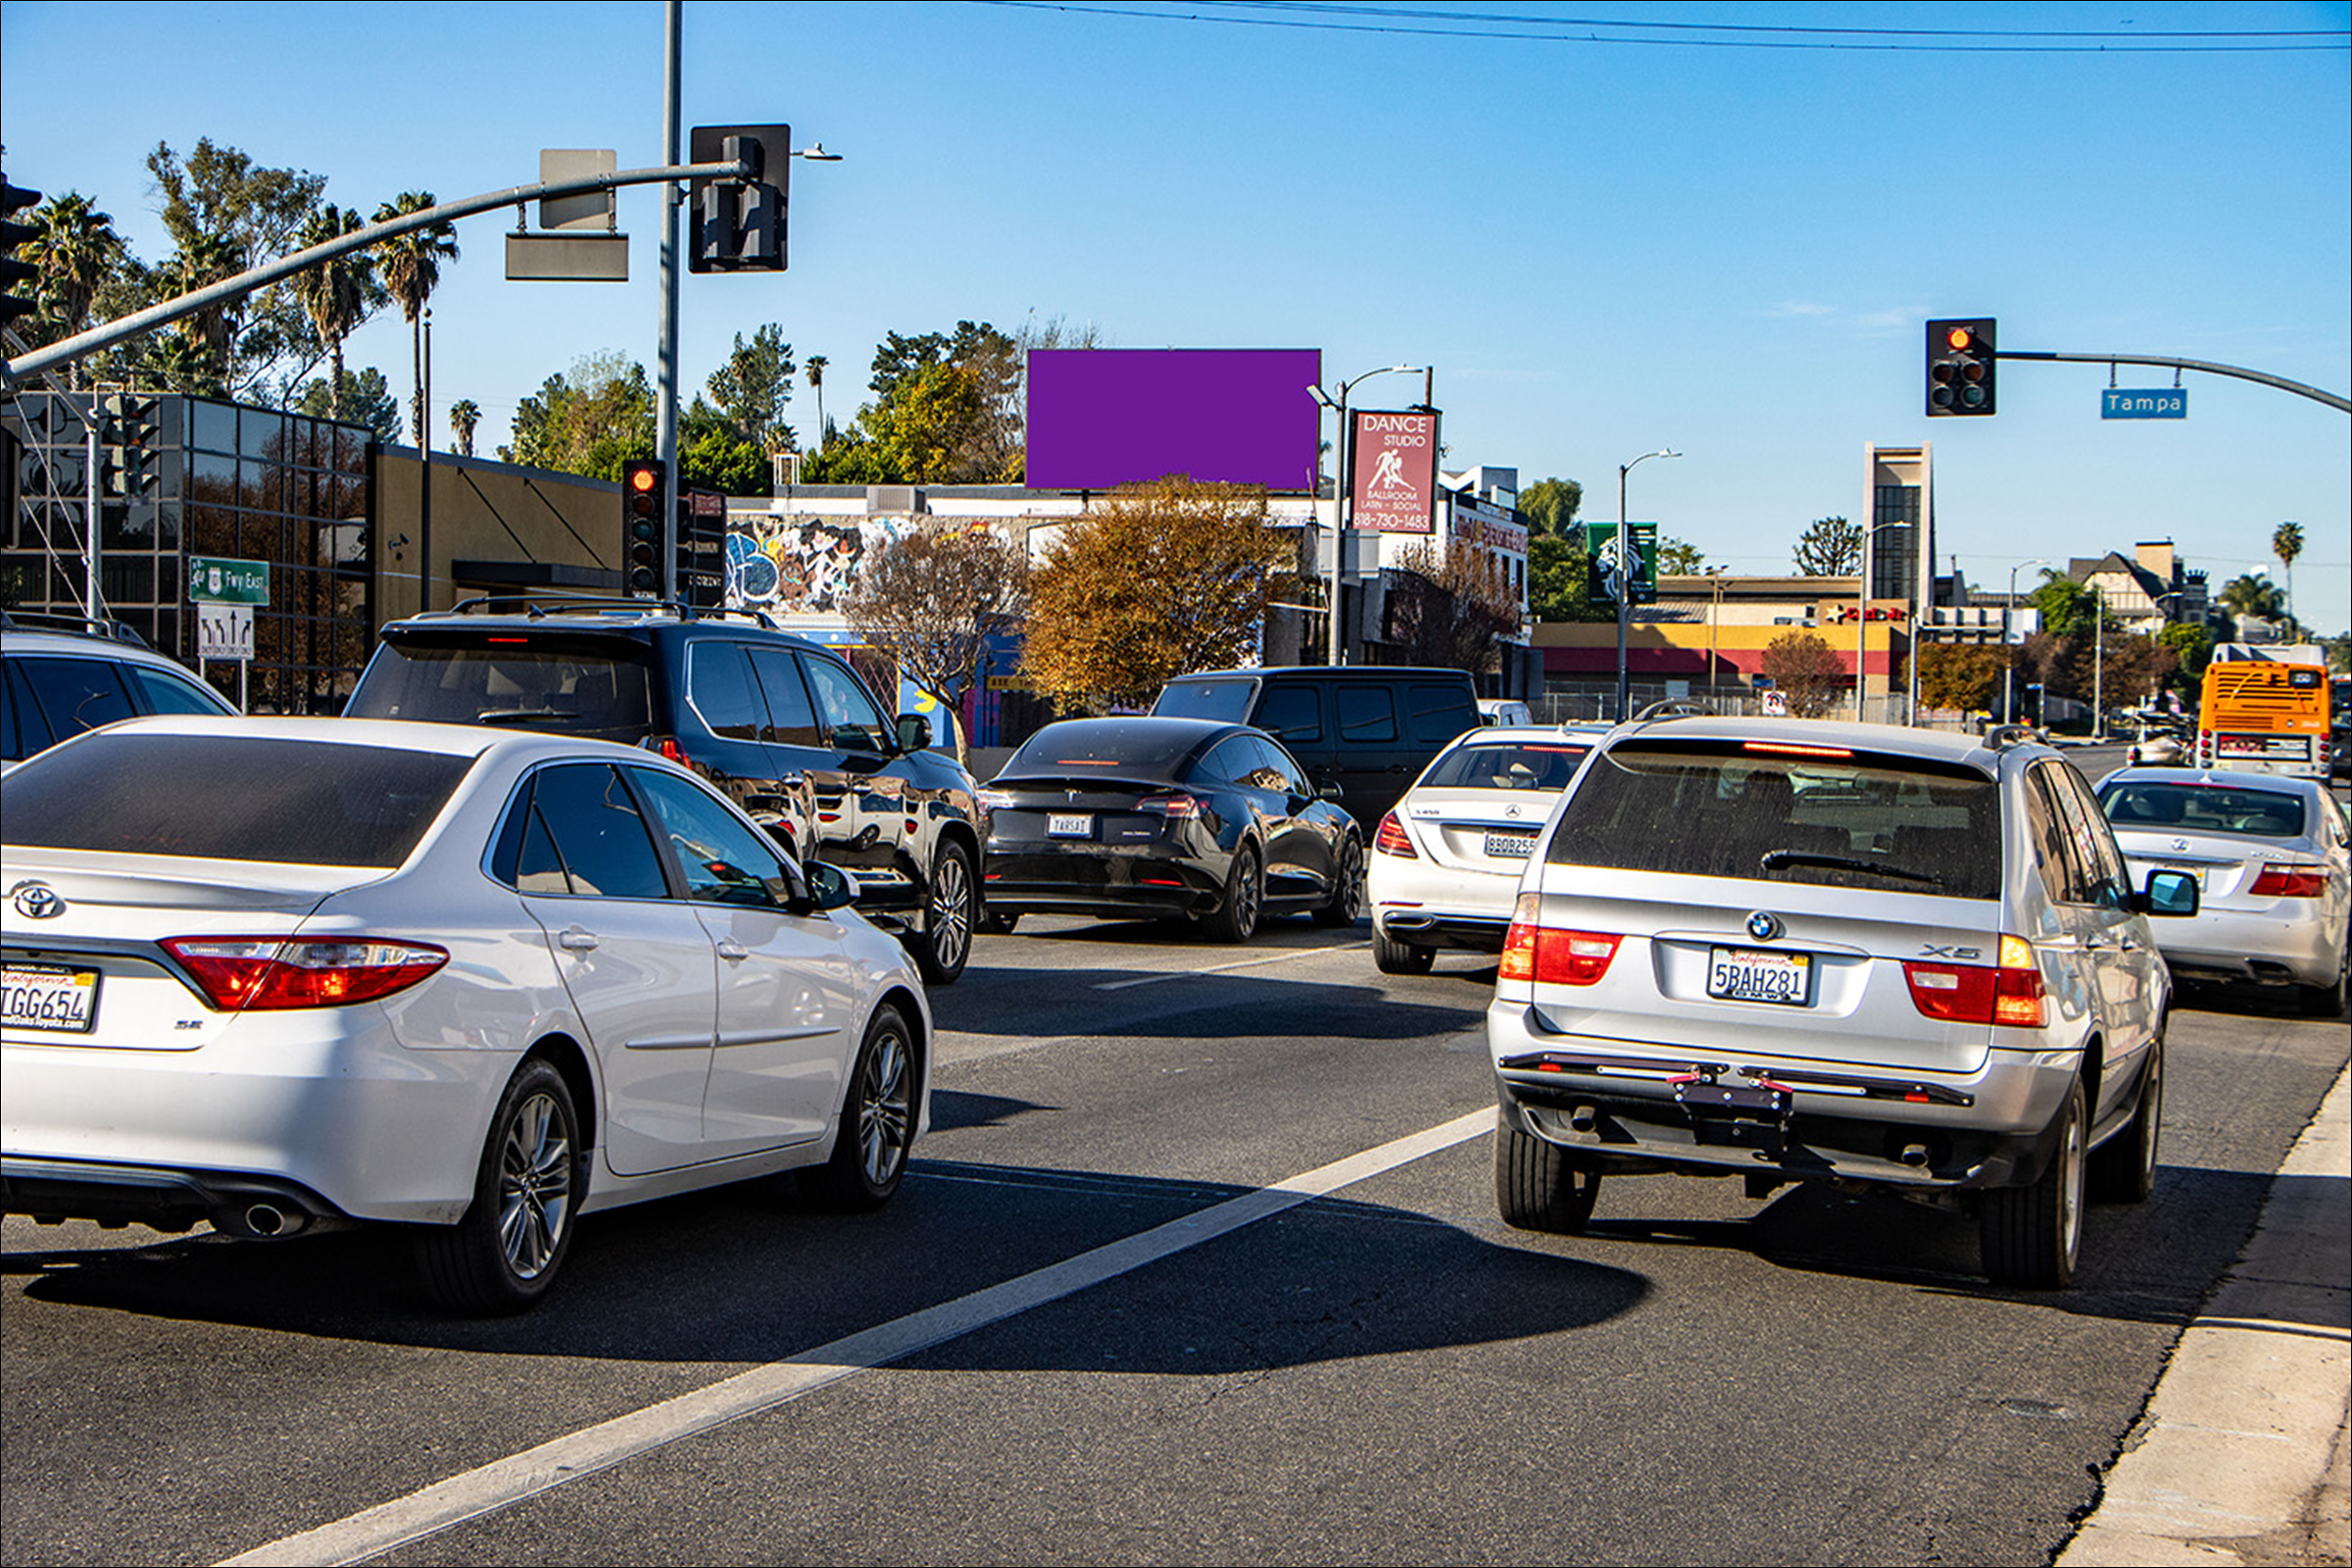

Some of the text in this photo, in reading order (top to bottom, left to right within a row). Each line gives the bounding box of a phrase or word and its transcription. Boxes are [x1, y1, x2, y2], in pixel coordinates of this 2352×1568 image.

[2108, 395, 2180, 413] Tampa
[1364, 416, 1427, 433] DANCE
[1384, 435, 1426, 447] STUDIO
[1367, 491, 1417, 501] BALLROOM
[1361, 501, 1383, 510] LATIN
[1393, 502, 1422, 512] SOCIAL
[1353, 513, 1429, 529] 818-730-1483
[225, 570, 243, 592] Fwy
[1918, 944, 1982, 959] X5
[1715, 963, 1801, 995] 5BAH281
